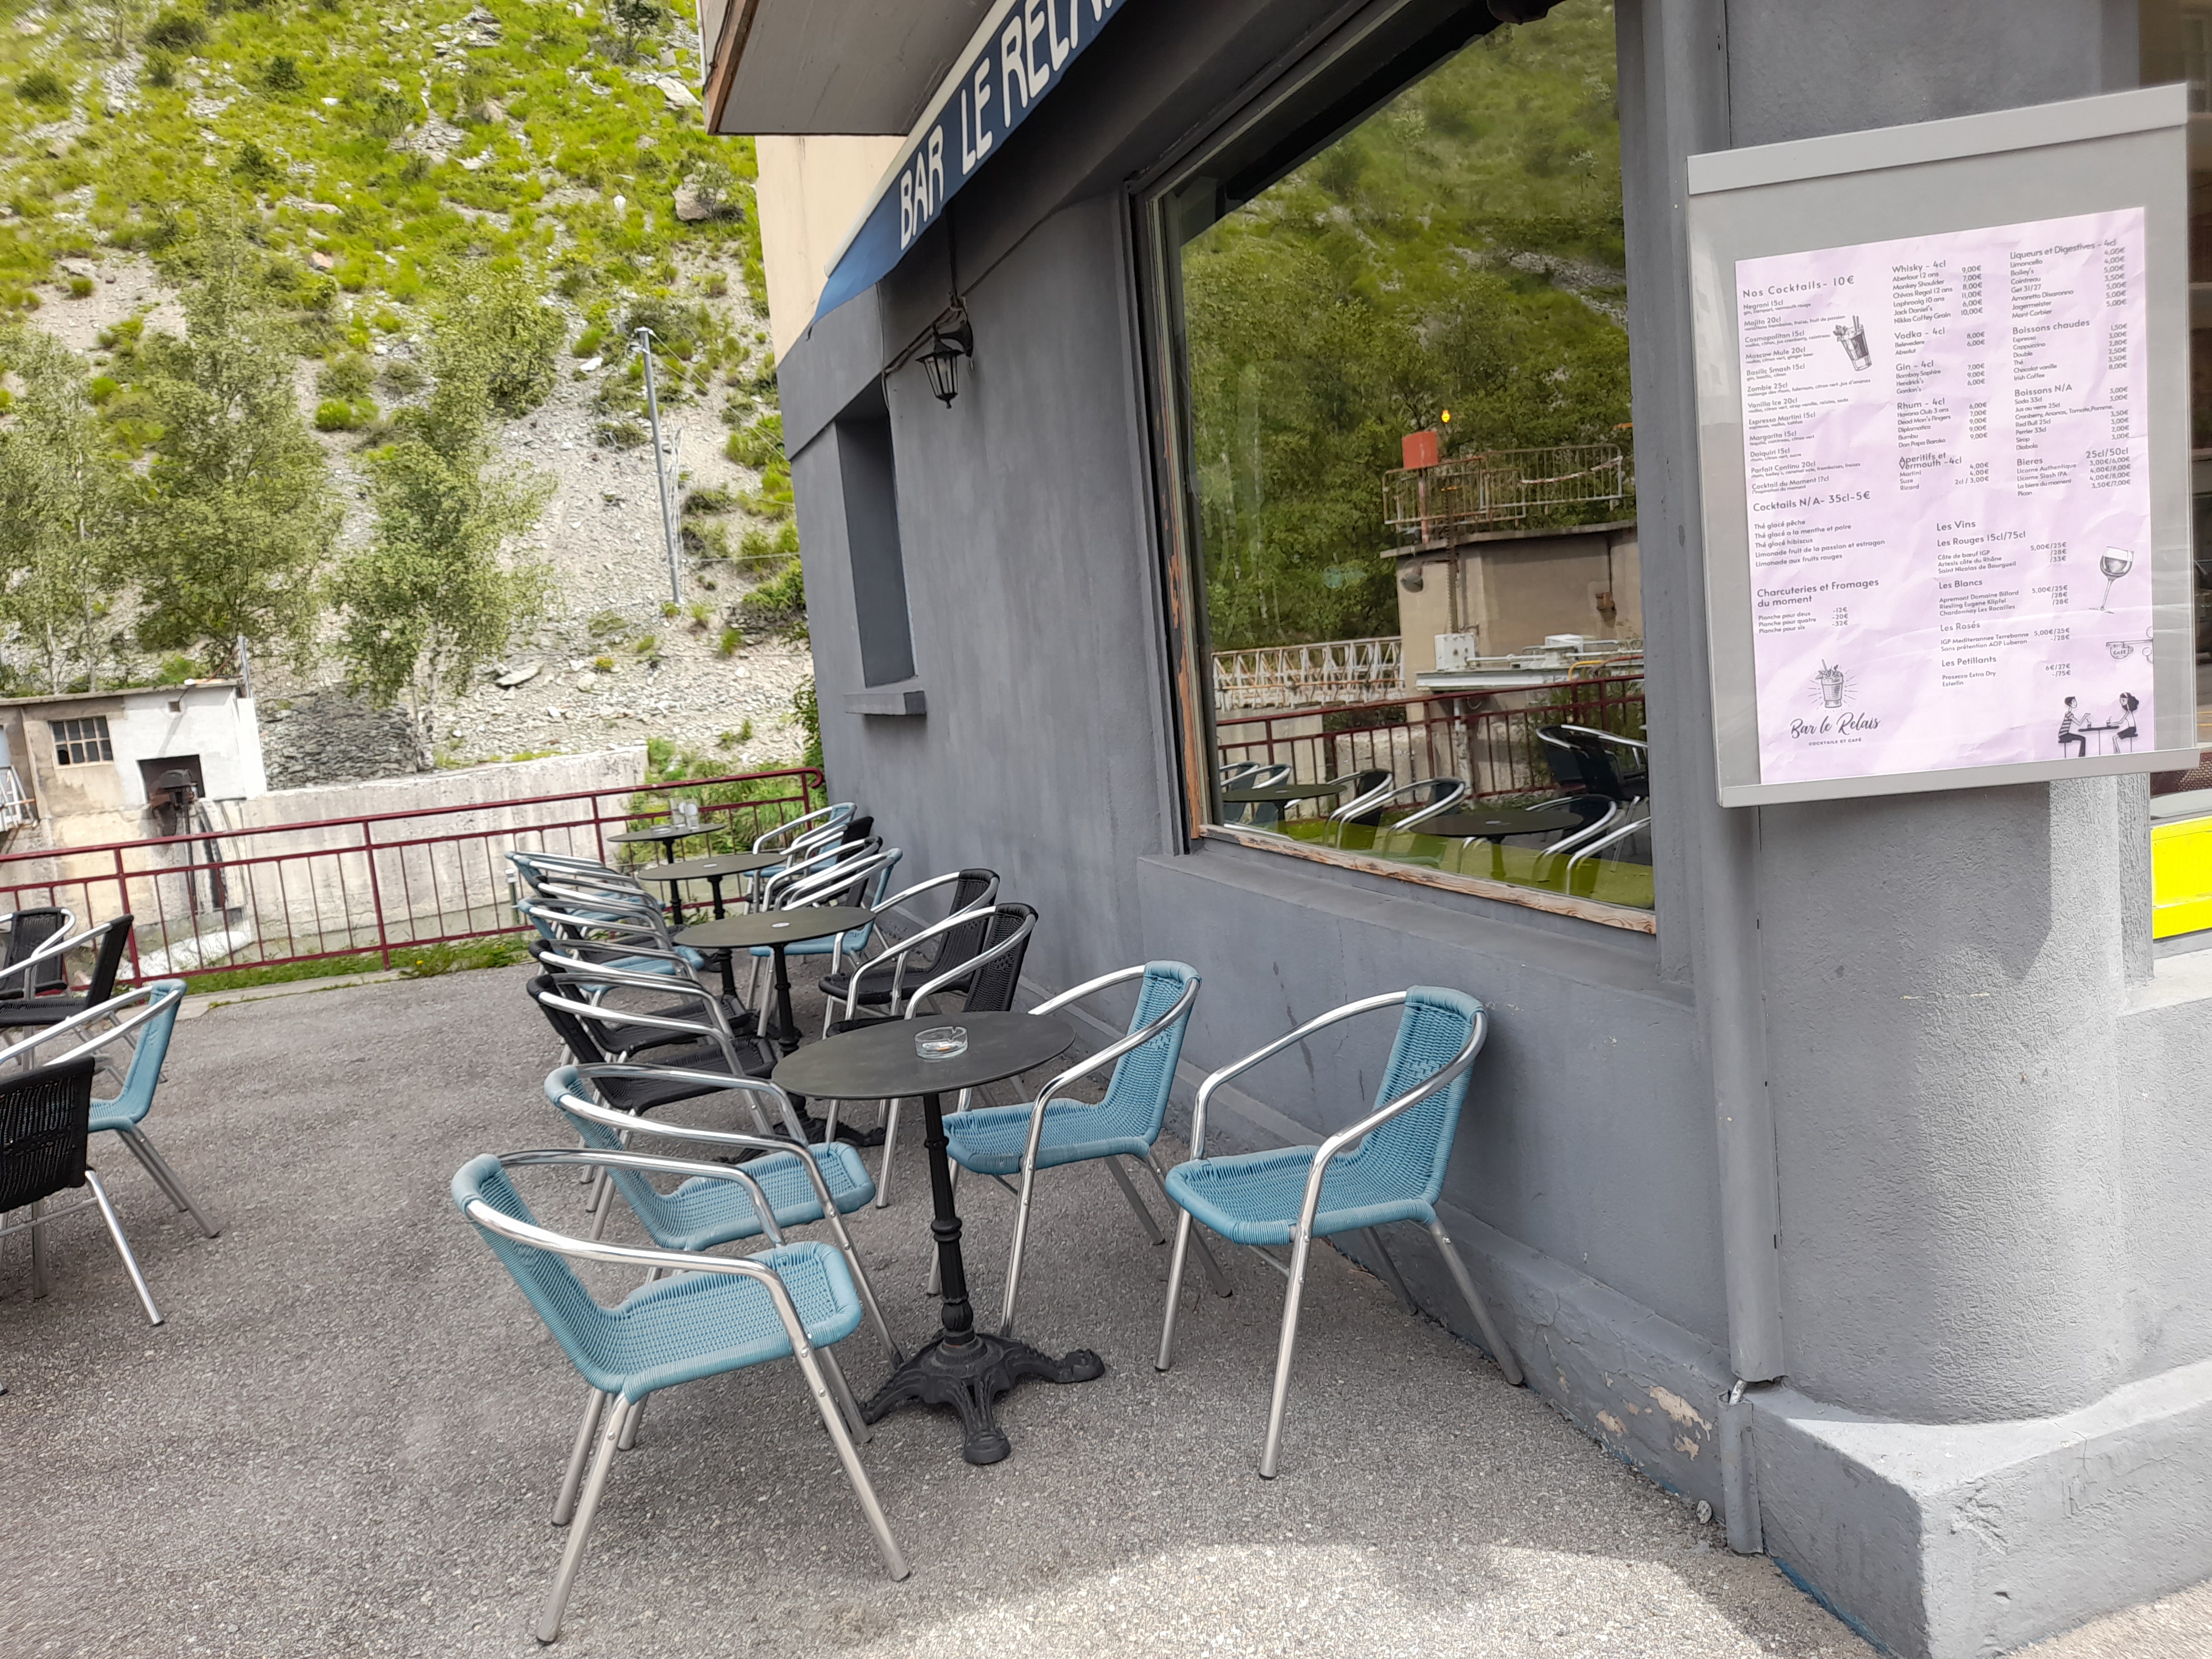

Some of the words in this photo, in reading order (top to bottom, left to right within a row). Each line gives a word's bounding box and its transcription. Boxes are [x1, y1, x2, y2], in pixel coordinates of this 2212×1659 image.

[900, 124, 943, 252] BAR
[961, 57, 993, 175] LE
[2009, 249, 2043, 260] Liqueurs
[2043, 247, 2053, 255] et
[2053, 242, 2095, 255] Digestives
[1891, 263, 1923, 273] Whisky
[1932, 259, 1946, 268] 4cl
[1891, 274, 1919, 283] Aberlour
[1961, 264, 1981, 274] 9,00€
[1742, 288, 1764, 299] Nos
[2023, 283, 2042, 292] 31/27
[1743, 301, 1769, 311] Negroni
[1893, 308, 1907, 316] Jack
[1908, 304, 1933, 314] Daniel's
[1961, 298, 1983, 307] 6,00€
[1911, 314, 1933, 322] Coffey
[1960, 306, 1983, 316] 10,00€
[1743, 319, 1765, 327] Mojito
[1766, 315, 1781, 324] 20cl
[2012, 325, 2051, 335] Boissons
[2052, 319, 2090, 330] chaudes
[1744, 332, 1791, 343] Cosmopolitan
[1791, 329, 1804, 337] 15cl
[1893, 330, 1922, 340] Vodka
[1932, 326, 1945, 335] 4cl
[1791, 346, 1806, 354] 20cl
[1746, 368, 1767, 376] Basilic
[1768, 364, 1791, 373] Smash
[1792, 362, 1805, 371] 15cl
[1895, 362, 1911, 372] Gin
[1920, 359, 1934, 368] 4cl
[1746, 384, 1772, 393] Zombie
[2014, 387, 2052, 397] Boissons
[2054, 383, 2073, 392] N/A
[1747, 400, 1771, 408] Vanilla
[1782, 397, 1798, 405] 20cl
[1896, 401, 1922, 410] Rhum
[1932, 397, 1945, 405] 4cl
[1748, 418, 1776, 426] Espresso
[1777, 413, 1802, 422] Martini
[1749, 432, 1782, 441] Margarita
[1749, 449, 1776, 458] Daiquiri
[1898, 452, 1936, 465] Aperitifs
[1937, 451, 1946, 460] et
[2085, 446, 2128, 459] 25cl/50cl
[1773, 463, 1799, 471] Continu
[1898, 458, 1941, 470] Vermouth
[1943, 456, 1962, 465] -4cl
[2016, 458, 2043, 466] Bieres
[1898, 469, 1922, 478] Martini
[1751, 481, 1778, 491] Cocktail
[1788, 477, 1817, 486] Moment
[1752, 499, 1797, 512] Cocktails
[1766, 520, 1785, 530] glacé
[1786, 519, 1806, 528] pêche
[1936, 522, 1952, 531] Les
[1954, 520, 1976, 529] Vins
[1766, 529, 1785, 540] glacé
[1800, 526, 1825, 534] menthe
[1834, 523, 1851, 533] poire
[1767, 539, 1786, 549] glacé
[1937, 539, 1950, 547] Les
[1952, 536, 1985, 546] Rouges
[1986, 530, 2026, 541] 15cl/75cl
[1755, 549, 1787, 558] Limonade
[1820, 543, 1846, 552] passion
[2030, 541, 2067, 551] 5,00€/25€
[1755, 558, 1787, 567] Limonade
[1756, 585, 1817, 598] Charcuteries
[1819, 582, 1829, 592] et
[1831, 579, 1879, 590] Fromages
[1938, 581, 1952, 589] Les
[1954, 579, 1983, 588] Blancs
[1757, 598, 1770, 608] du
[1772, 594, 1812, 606] moment
[1955, 619, 1980, 630] Rosés
[1957, 655, 1997, 665] Petillants
[2044, 662, 2070, 671] 6€/27€
[1790, 718, 1817, 739] Bar
[1819, 715, 1832, 734] le
[1835, 711, 1880, 735] Relais
